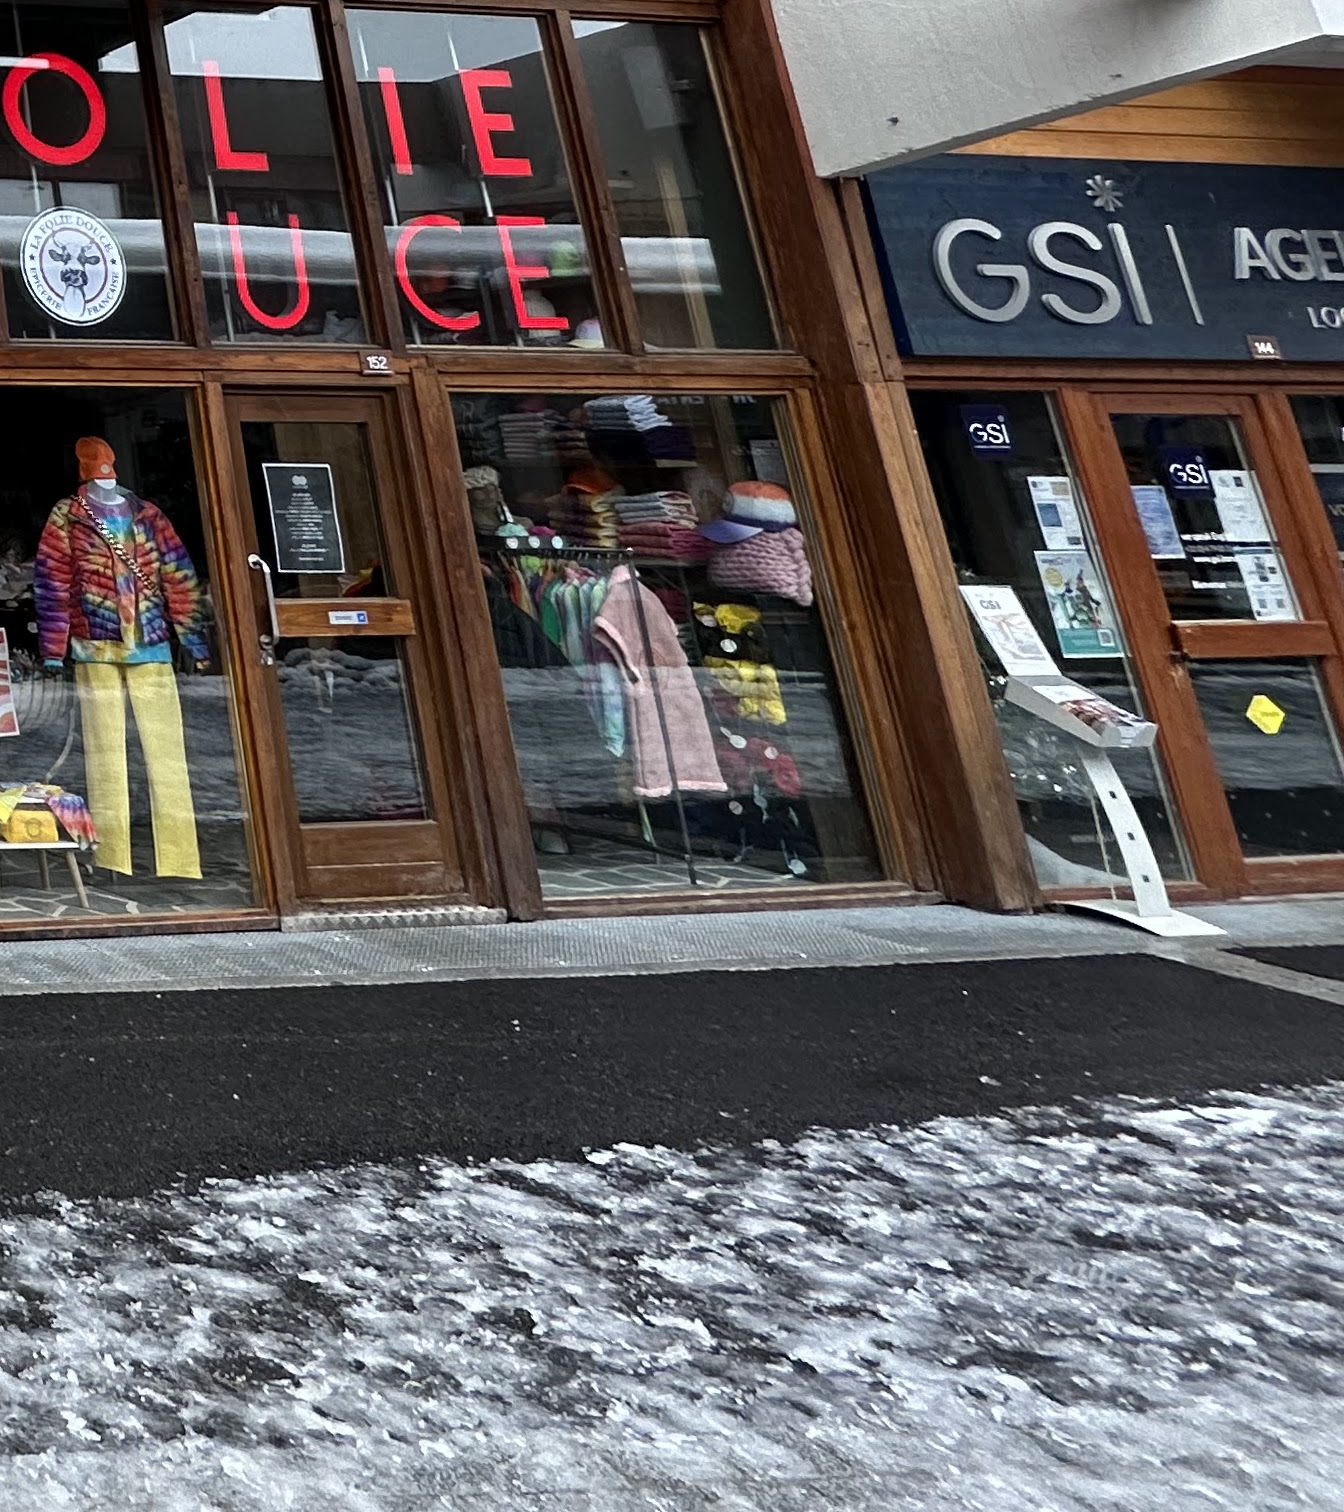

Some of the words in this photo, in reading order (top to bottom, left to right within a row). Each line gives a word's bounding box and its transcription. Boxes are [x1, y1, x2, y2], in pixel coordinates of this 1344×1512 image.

[38, 214, 73, 235] FOLIE
[75, 216, 115, 254] DOUCE
[1234, 227, 1344, 282] AGE
[366, 355, 390, 370] 152
